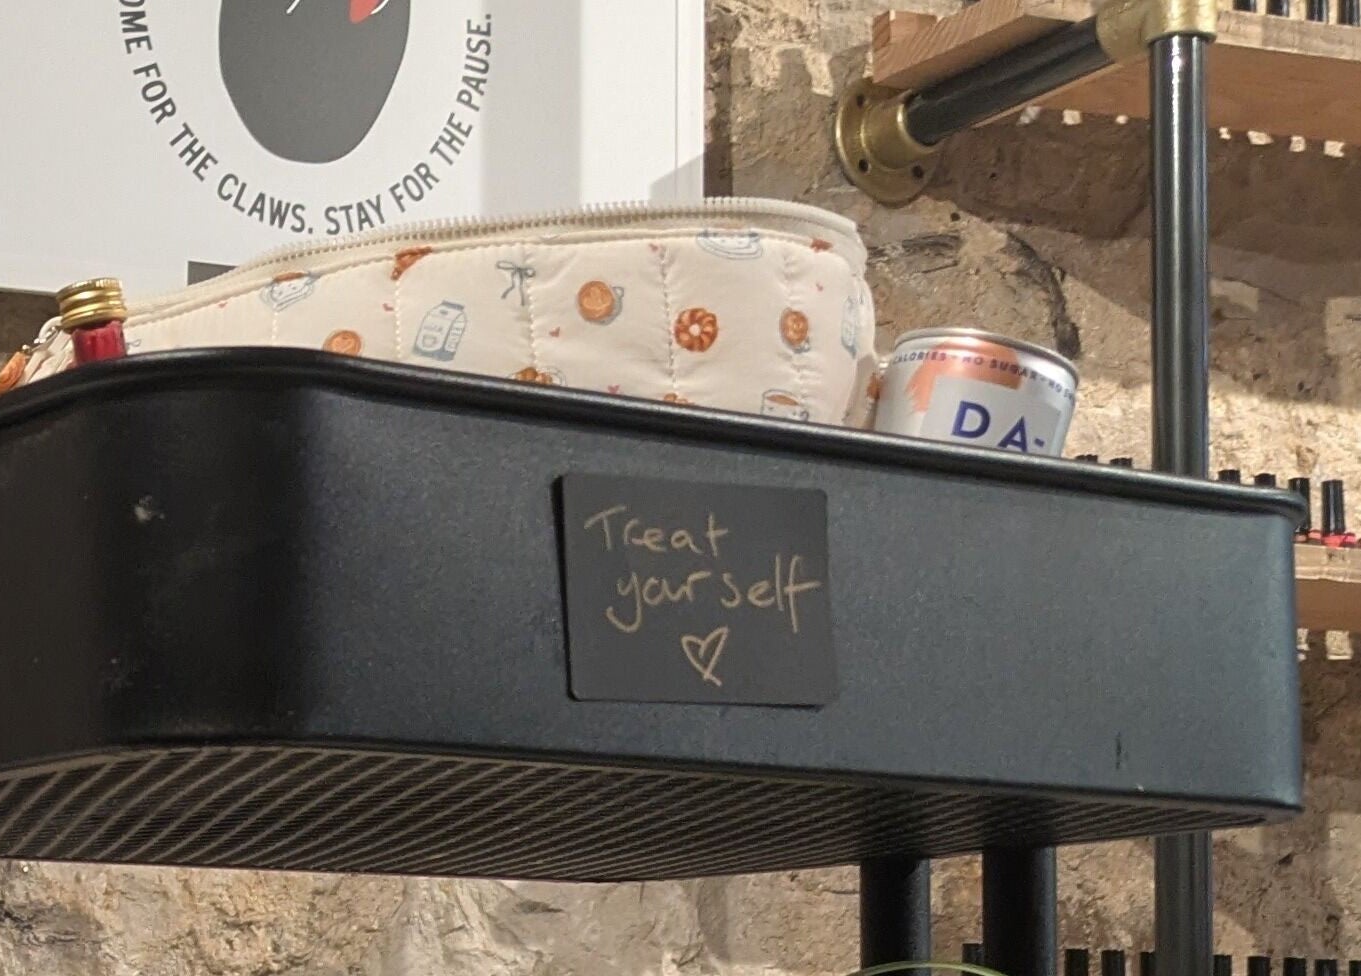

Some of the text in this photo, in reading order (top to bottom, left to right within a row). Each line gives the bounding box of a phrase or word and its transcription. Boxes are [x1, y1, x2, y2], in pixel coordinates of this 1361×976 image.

[133, 62, 176, 124] FOR
[168, 123, 217, 182] THE
[216, 173, 314, 235] CLAWS.
[324, 194, 387, 236] STAY
[388, 162, 441, 213] FOR
[429, 112, 474, 167] THE
[458, 12, 493, 112] PAUSE.
[584, 504, 729, 557] Treat
